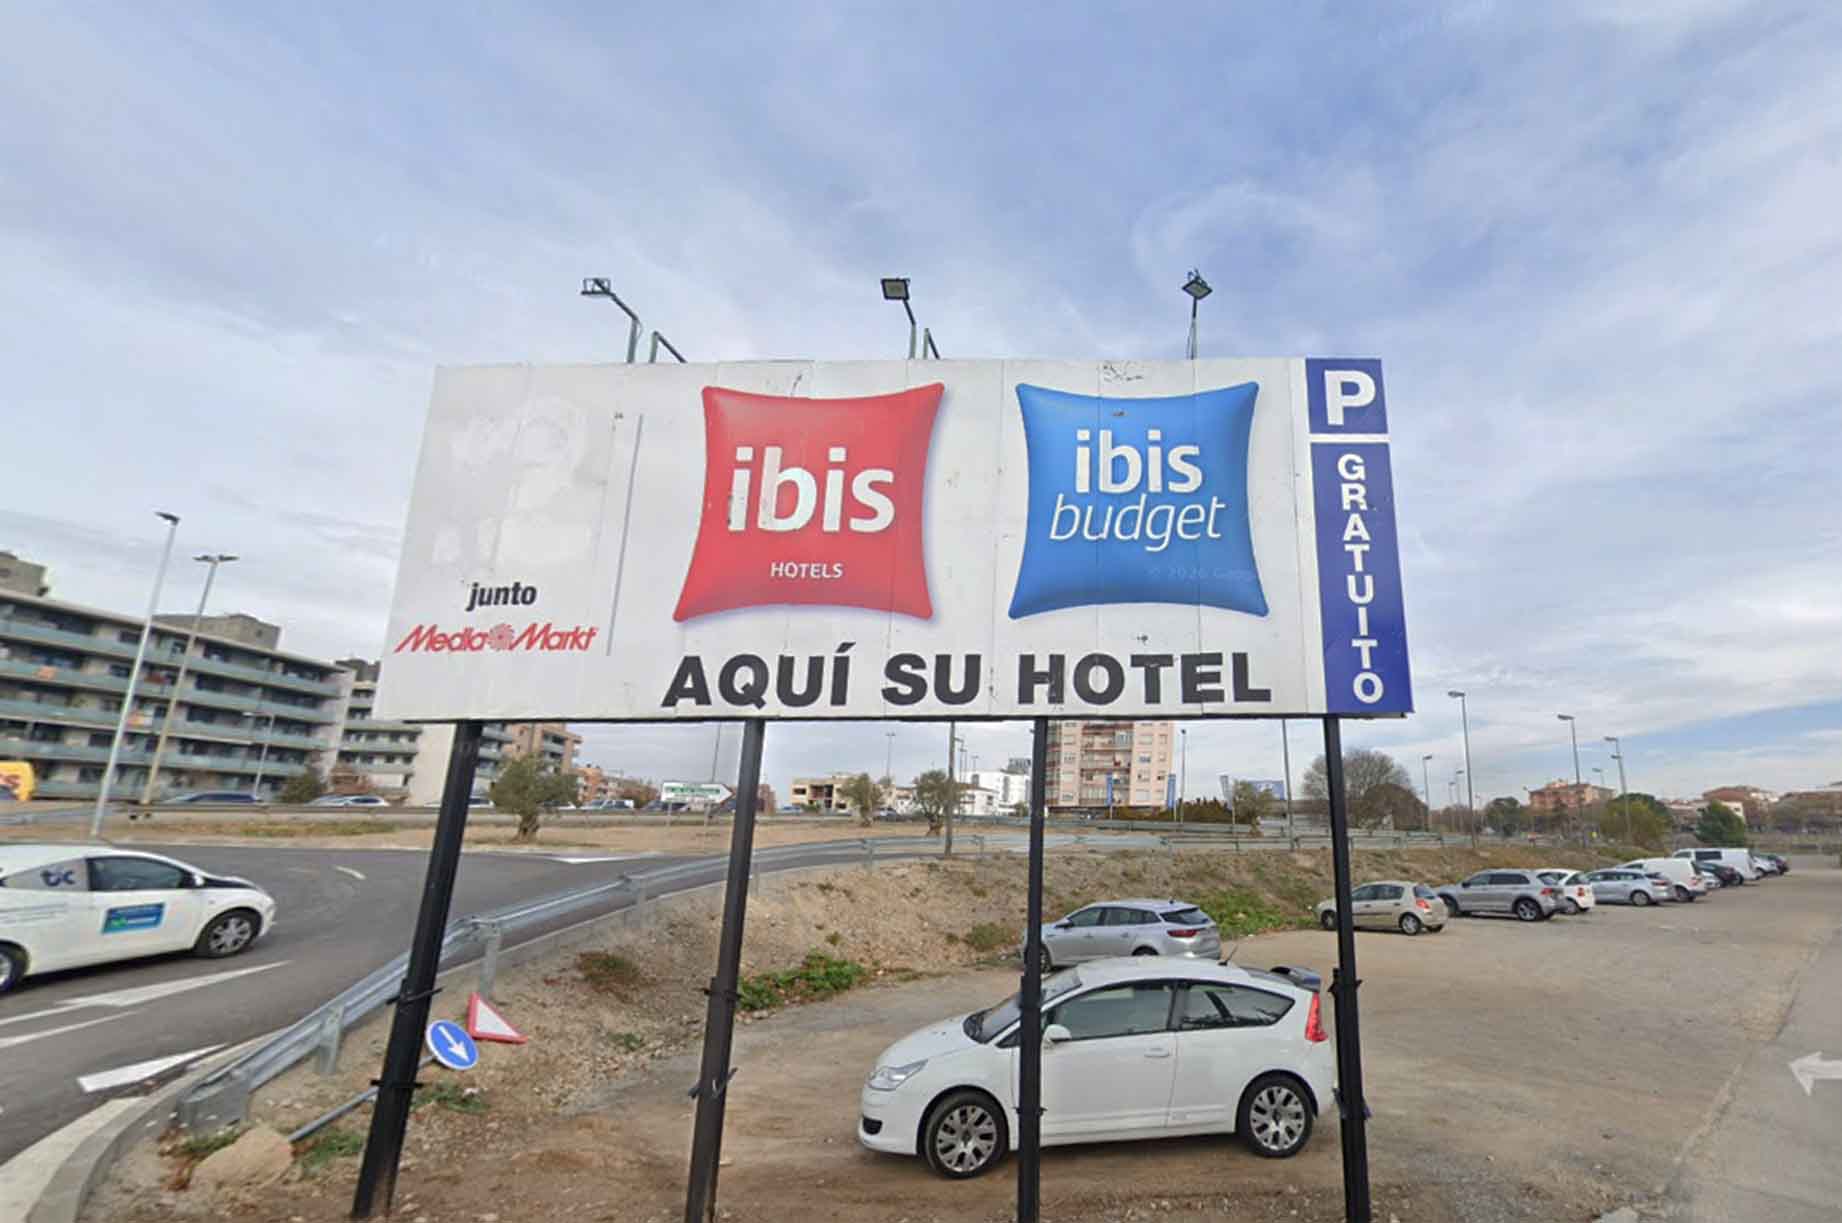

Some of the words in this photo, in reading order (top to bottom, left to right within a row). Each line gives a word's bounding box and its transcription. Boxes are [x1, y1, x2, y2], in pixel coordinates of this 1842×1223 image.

[1322, 369, 1376, 426] P
[726, 446, 897, 533] ibis
[1073, 429, 1205, 495] ibis
[1048, 494, 1226, 553] budget
[465, 582, 537, 612] junto
[769, 561, 844, 580] HOTELS
[1336, 453, 1386, 704] GRATUITO
[660, 642, 857, 710] AQUÍ
[881, 652, 983, 706] SU
[1016, 652, 1272, 705] HOTEL
